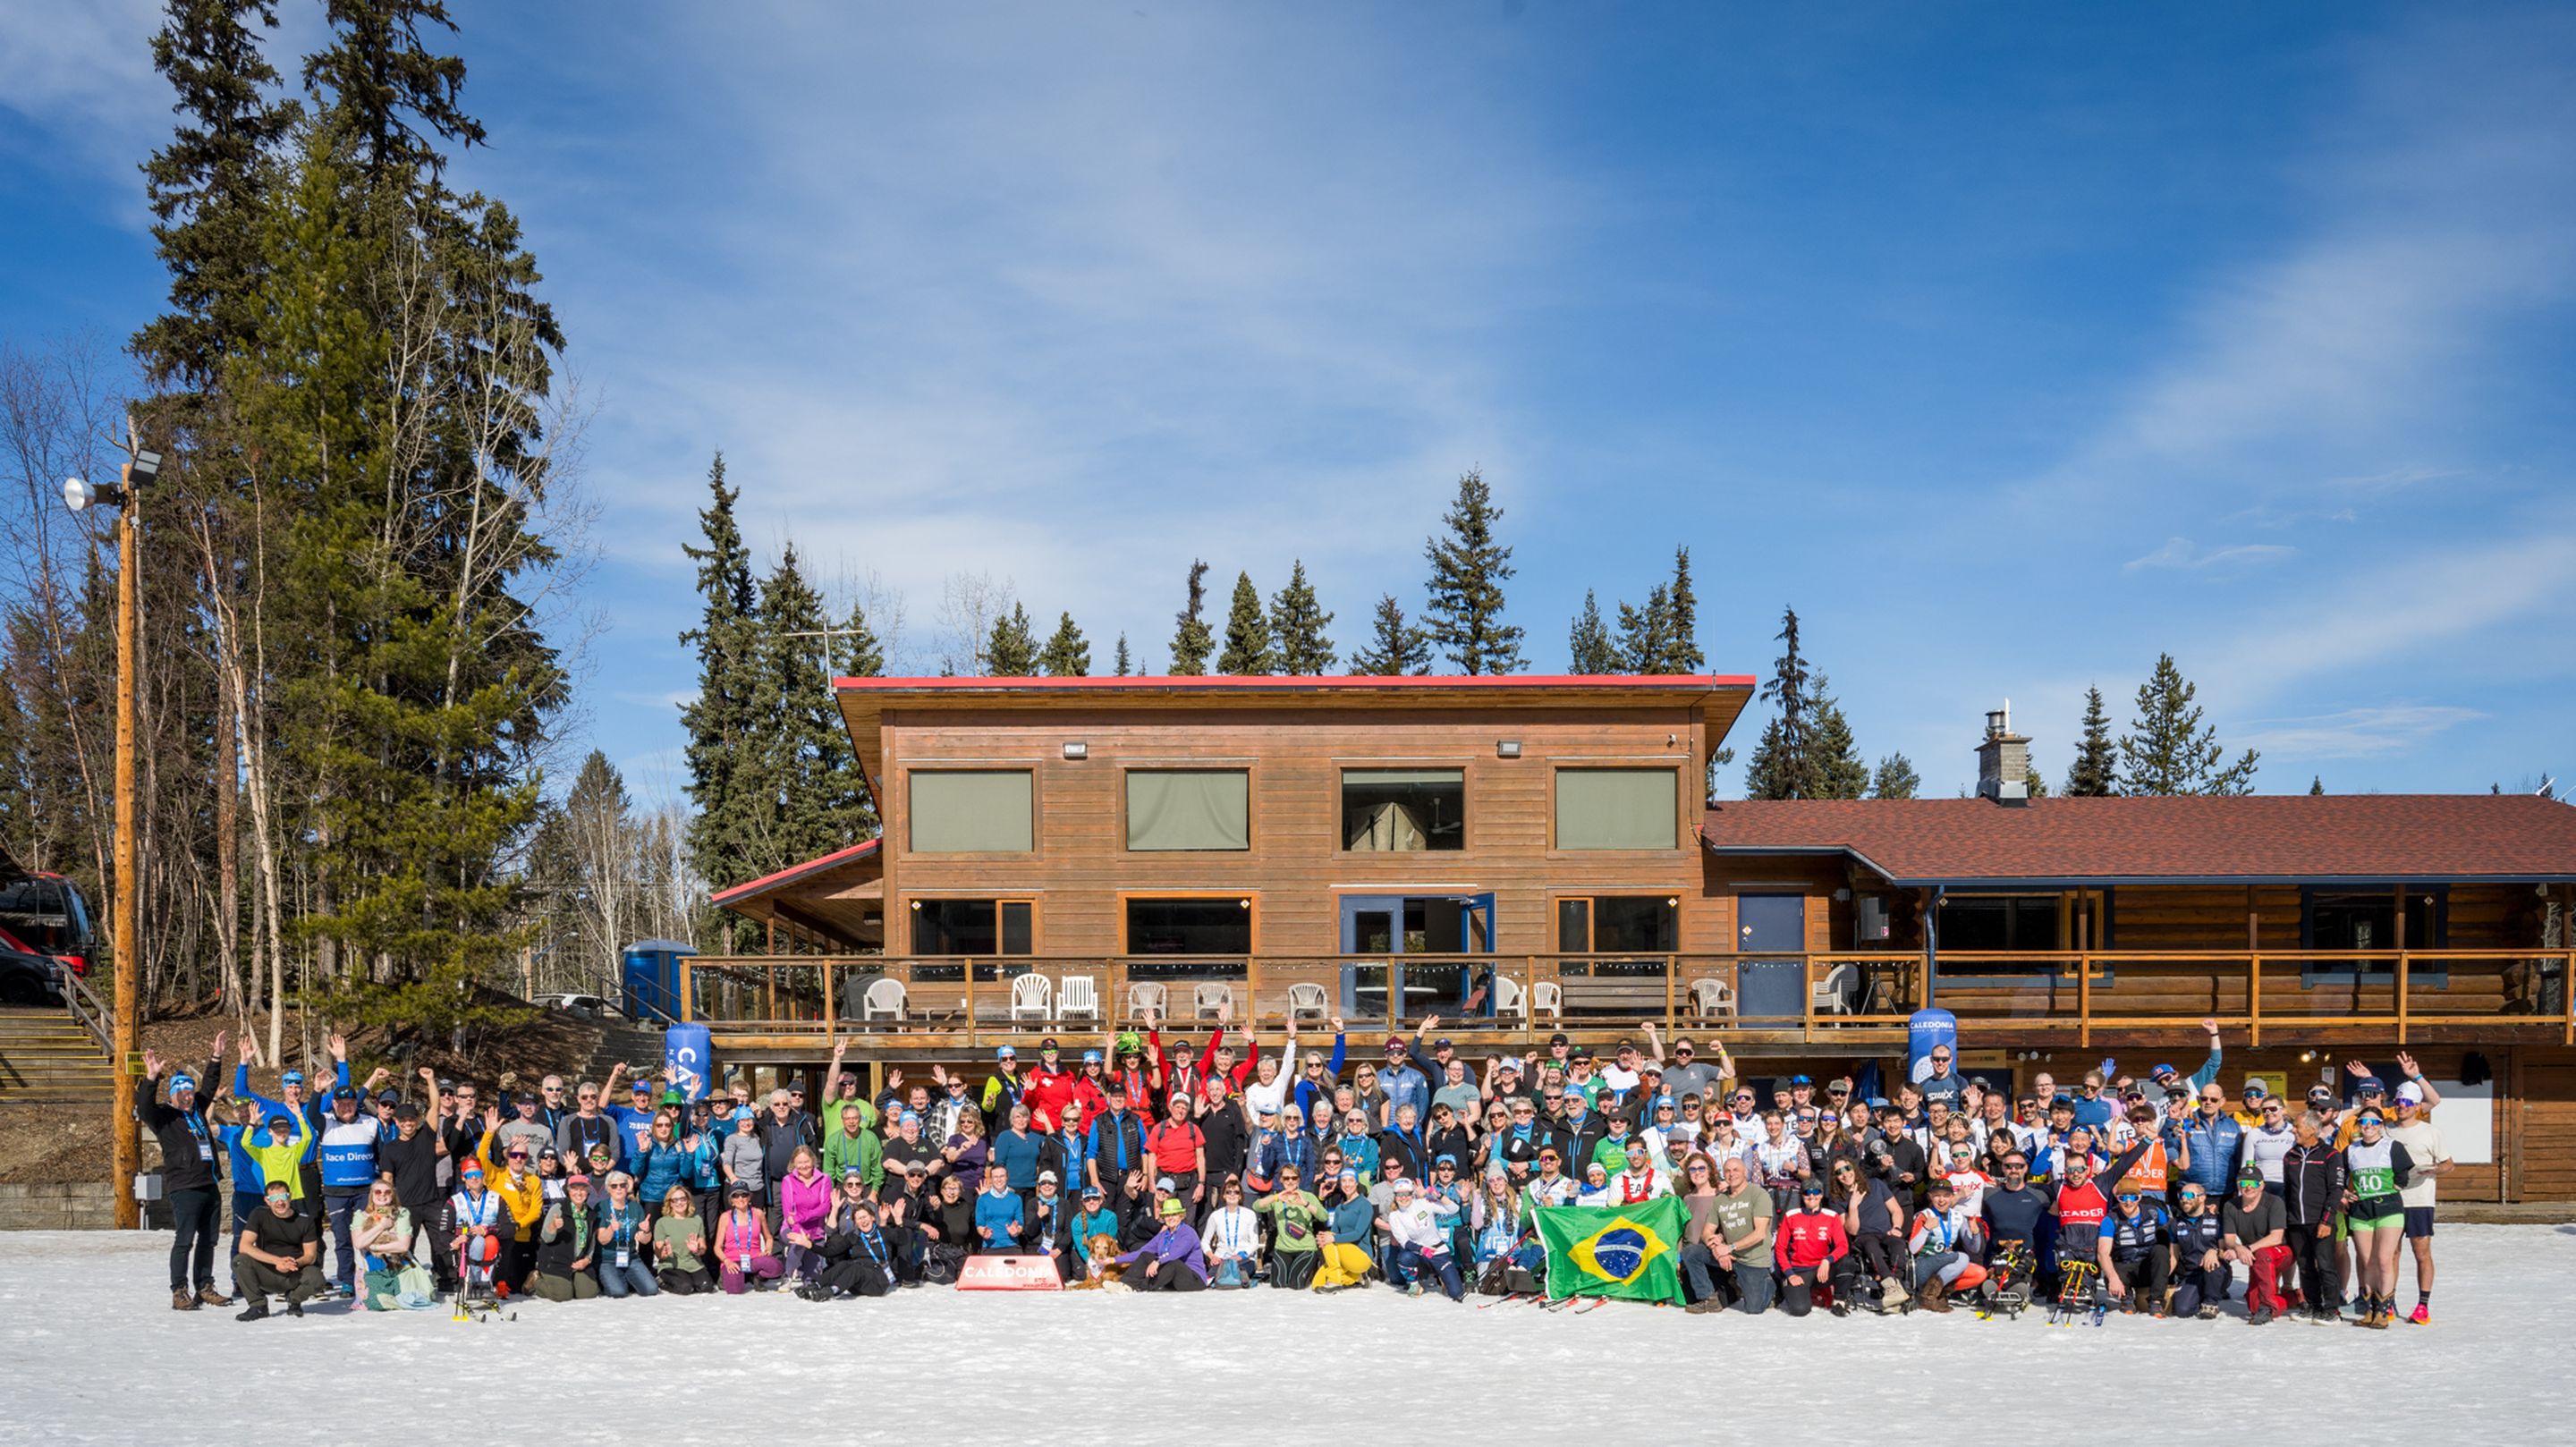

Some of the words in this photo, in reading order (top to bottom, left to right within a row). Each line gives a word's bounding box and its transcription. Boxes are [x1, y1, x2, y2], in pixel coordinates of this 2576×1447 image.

[1910, 1021, 1954, 1029] CALEDONIA
[2359, 1174, 2382, 1191] 40
[2060, 1208, 2104, 1217] LEADER
[965, 1266, 1055, 1278] CALEDONIA
